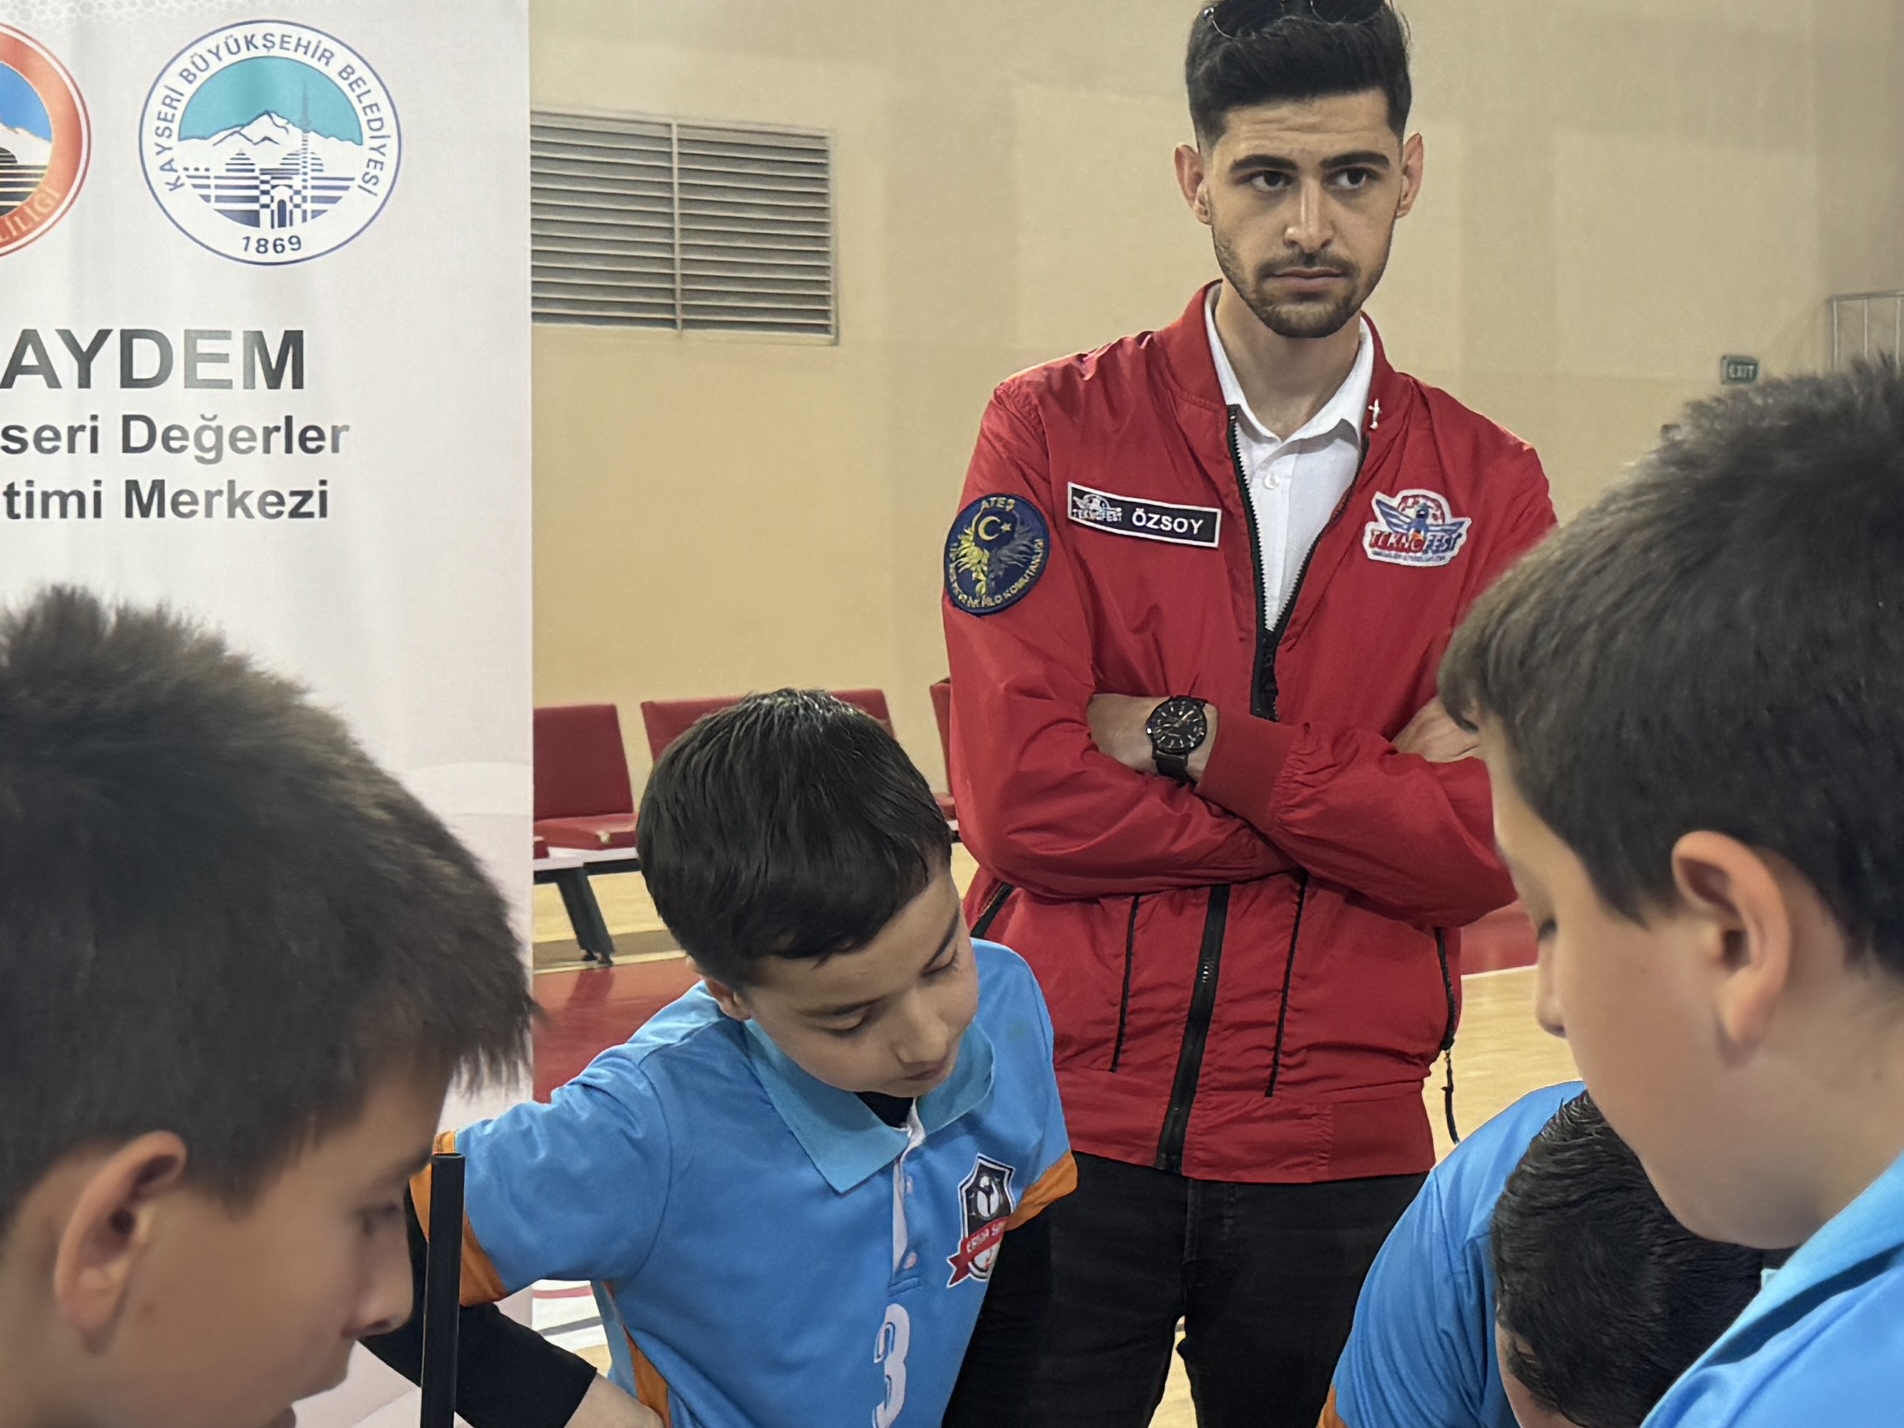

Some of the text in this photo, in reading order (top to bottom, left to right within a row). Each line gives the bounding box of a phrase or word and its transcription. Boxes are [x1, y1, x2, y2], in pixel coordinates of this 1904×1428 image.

[154, 84, 185, 192] KAYSERİ
[179, 31, 335, 85] BÜYÜKŞEHİR
[242, 235, 302, 255] 1869
[121, 413, 351, 466] Değerler
[123, 479, 330, 521] Merkezi
[1132, 507, 1203, 534] ÖZSOY
